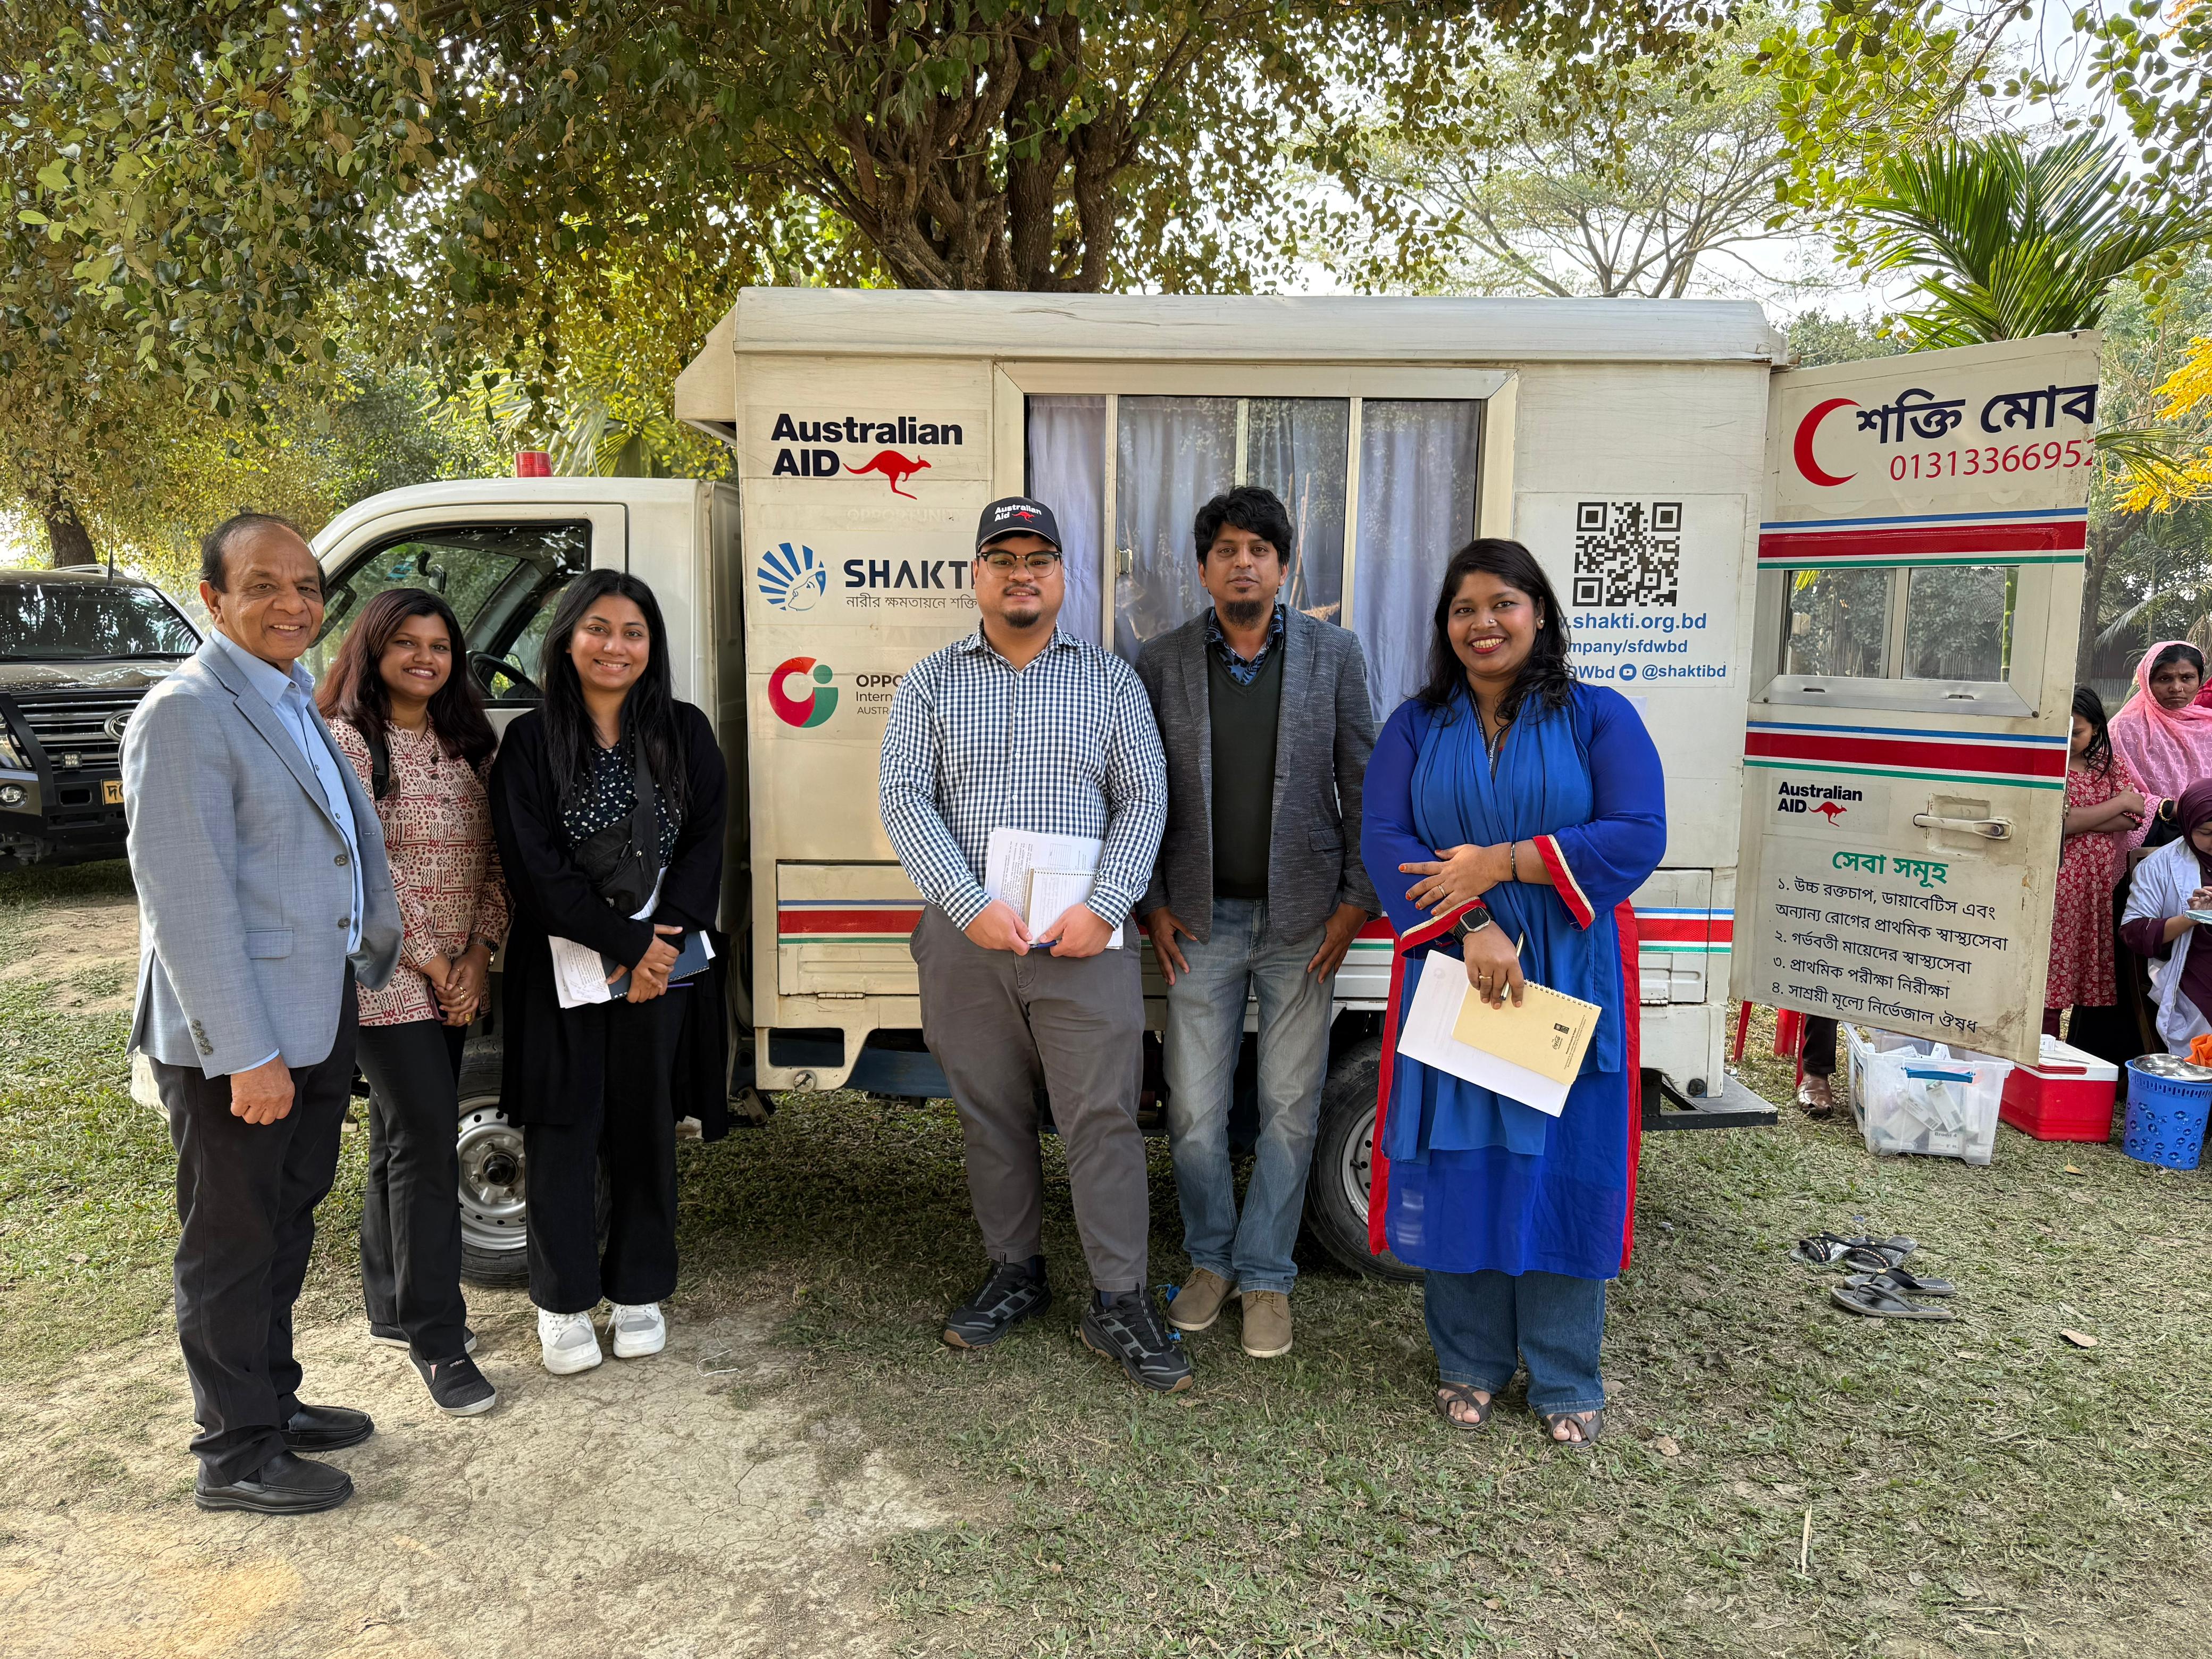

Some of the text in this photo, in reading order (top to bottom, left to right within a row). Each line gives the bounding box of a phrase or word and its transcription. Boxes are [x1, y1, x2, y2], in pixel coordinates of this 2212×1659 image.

[1856, 388, 1966, 443] শক্তি
[771, 414, 963, 445] Australian
[772, 449, 840, 476] AID
[994, 512, 1010, 522] Aid
[995, 504, 1042, 515] Australian
[846, 592, 977, 609] নারীর ক্ষমতায়নে শক্তি
[1564, 613, 1706, 633] .shakti.org.bd
[1568, 640, 1688, 656] mpany/sfdwbd
[856, 674, 903, 687] OPPO
[1569, 665, 1726, 680] DWbd @shaktibd
[856, 691, 892, 701] Intern
[1778, 782, 1862, 801] Australian
[1777, 798, 1807, 813] AID
[1832, 851, 1948, 889] সেবা সমূহ
[1794, 875, 1820, 893] উচ্চ
[1823, 884, 1876, 904] রক্তচাপ,
[1881, 892, 1958, 914] ডায়াবেটিস
[1963, 904, 1995, 920] এবং
[1775, 904, 2008, 951] অন্যান্য রোগের প্রাথমিক স্বাস্থ্যসেবা
[1792, 931, 1839, 951] গর্ভবতী
[1842, 941, 1899, 961] মায়েদের
[1903, 951, 1972, 974] স্বাস্থ্যসেবা
[1790, 959, 1844, 978] প্রাথমিক
[1848, 967, 1894, 988] পরীক্ষা
[1898, 974, 1950, 999] নিরীক্ষা
[1788, 985, 1829, 1003] সাশ্রয়ী
[1832, 993, 1864, 1011] মূল্যে
[1868, 996, 1934, 1025] নির্ভেজাল
[1939, 1010, 1978, 1033] ঔষধ
